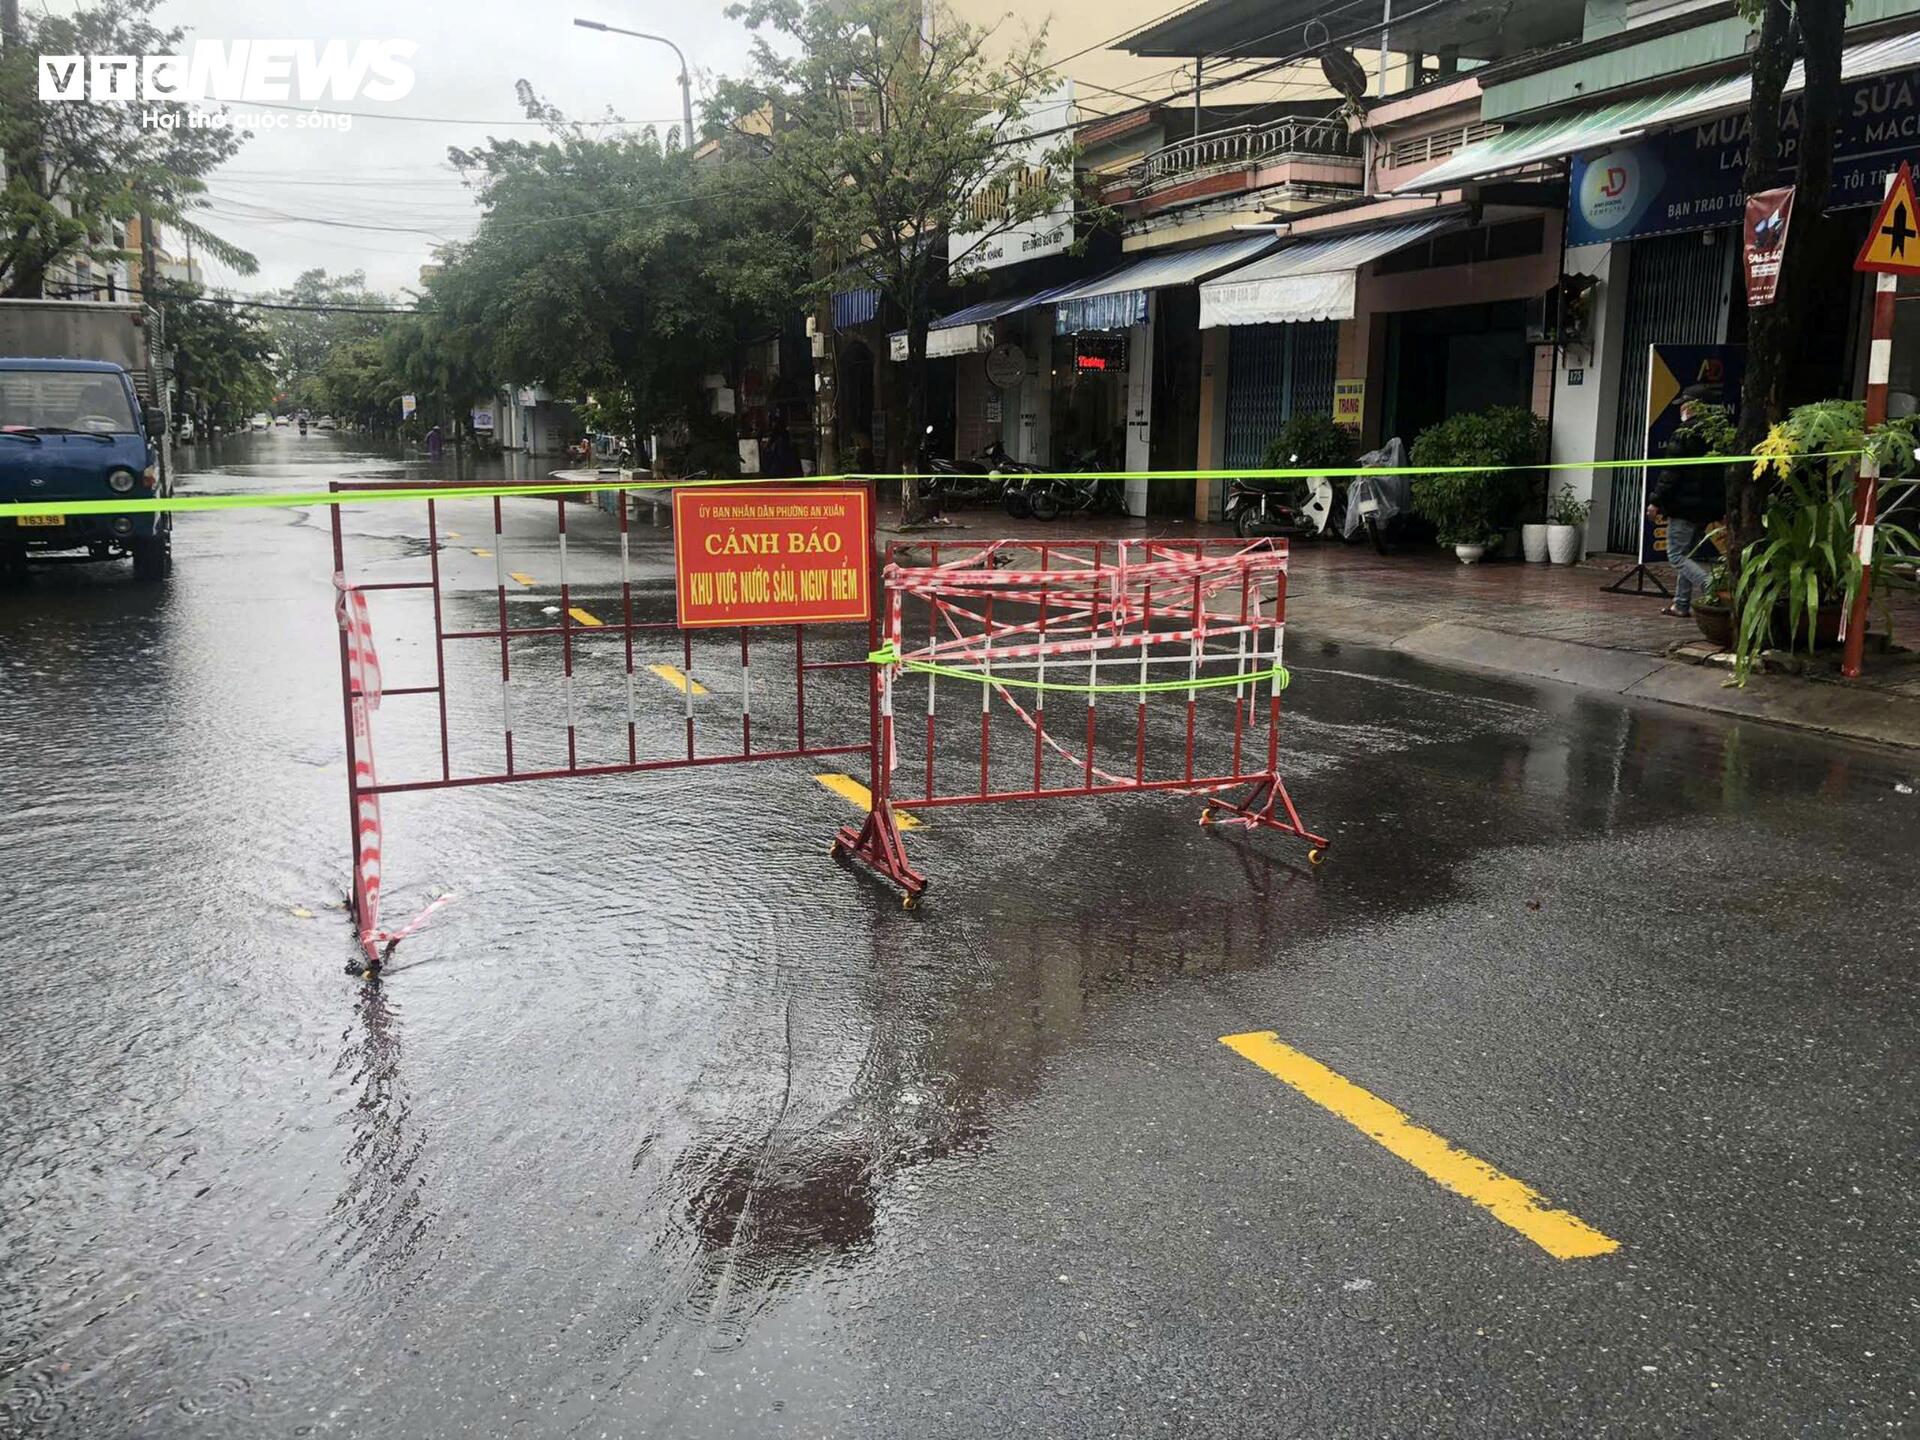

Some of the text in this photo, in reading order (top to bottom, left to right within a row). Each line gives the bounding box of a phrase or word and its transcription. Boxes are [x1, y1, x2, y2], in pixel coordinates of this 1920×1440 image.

[1667, 202, 1690, 220] BẠN
[1695, 195, 1724, 213] TRAO
[1843, 170, 1865, 190] TÔI
[713, 506, 730, 518] BAN
[732, 504, 756, 518] NHÂN
[757, 504, 775, 517] DÂN
[810, 505, 822, 517] AN
[823, 503, 845, 517] XUÂN
[705, 526, 841, 555] CẢNH BÁO
[690, 555, 858, 611] KHU VỰC NƯỚC SÂU, NGUY HIỂM
